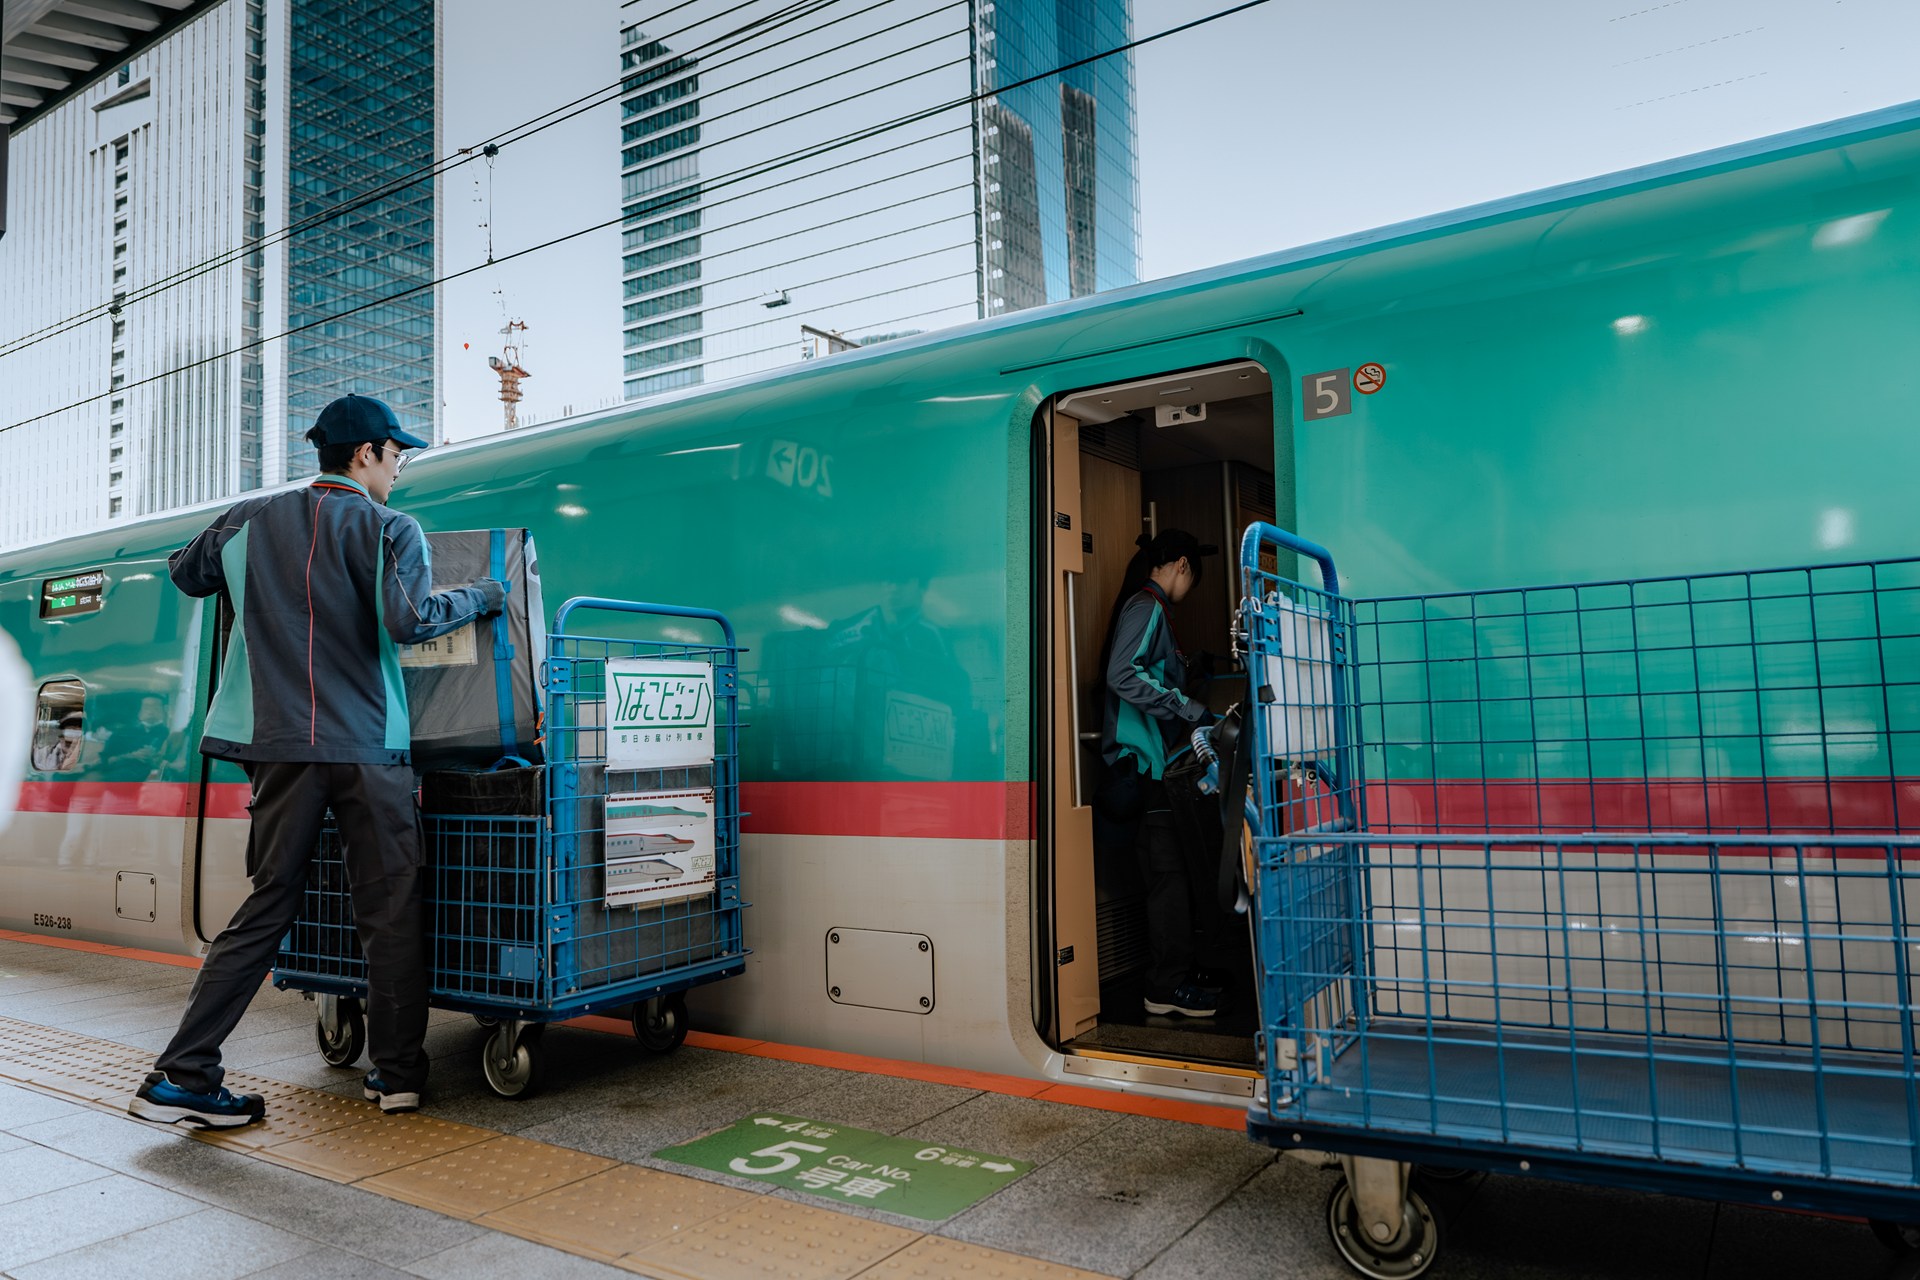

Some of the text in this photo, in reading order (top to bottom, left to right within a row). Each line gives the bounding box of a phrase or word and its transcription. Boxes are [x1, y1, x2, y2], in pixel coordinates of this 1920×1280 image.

[1315, 375, 1339, 414] 5
[621, 681, 704, 721] はこビュン
[621, 732, 703, 744] 即日お届け列車便
[34, 913, 72, 929] E526-238
[779, 1121, 810, 1133] 4
[728, 1140, 828, 1175] 5
[914, 1147, 947, 1161] 6
[826, 1155, 912, 1182] Car No.
[794, 1166, 896, 1199] 号車
